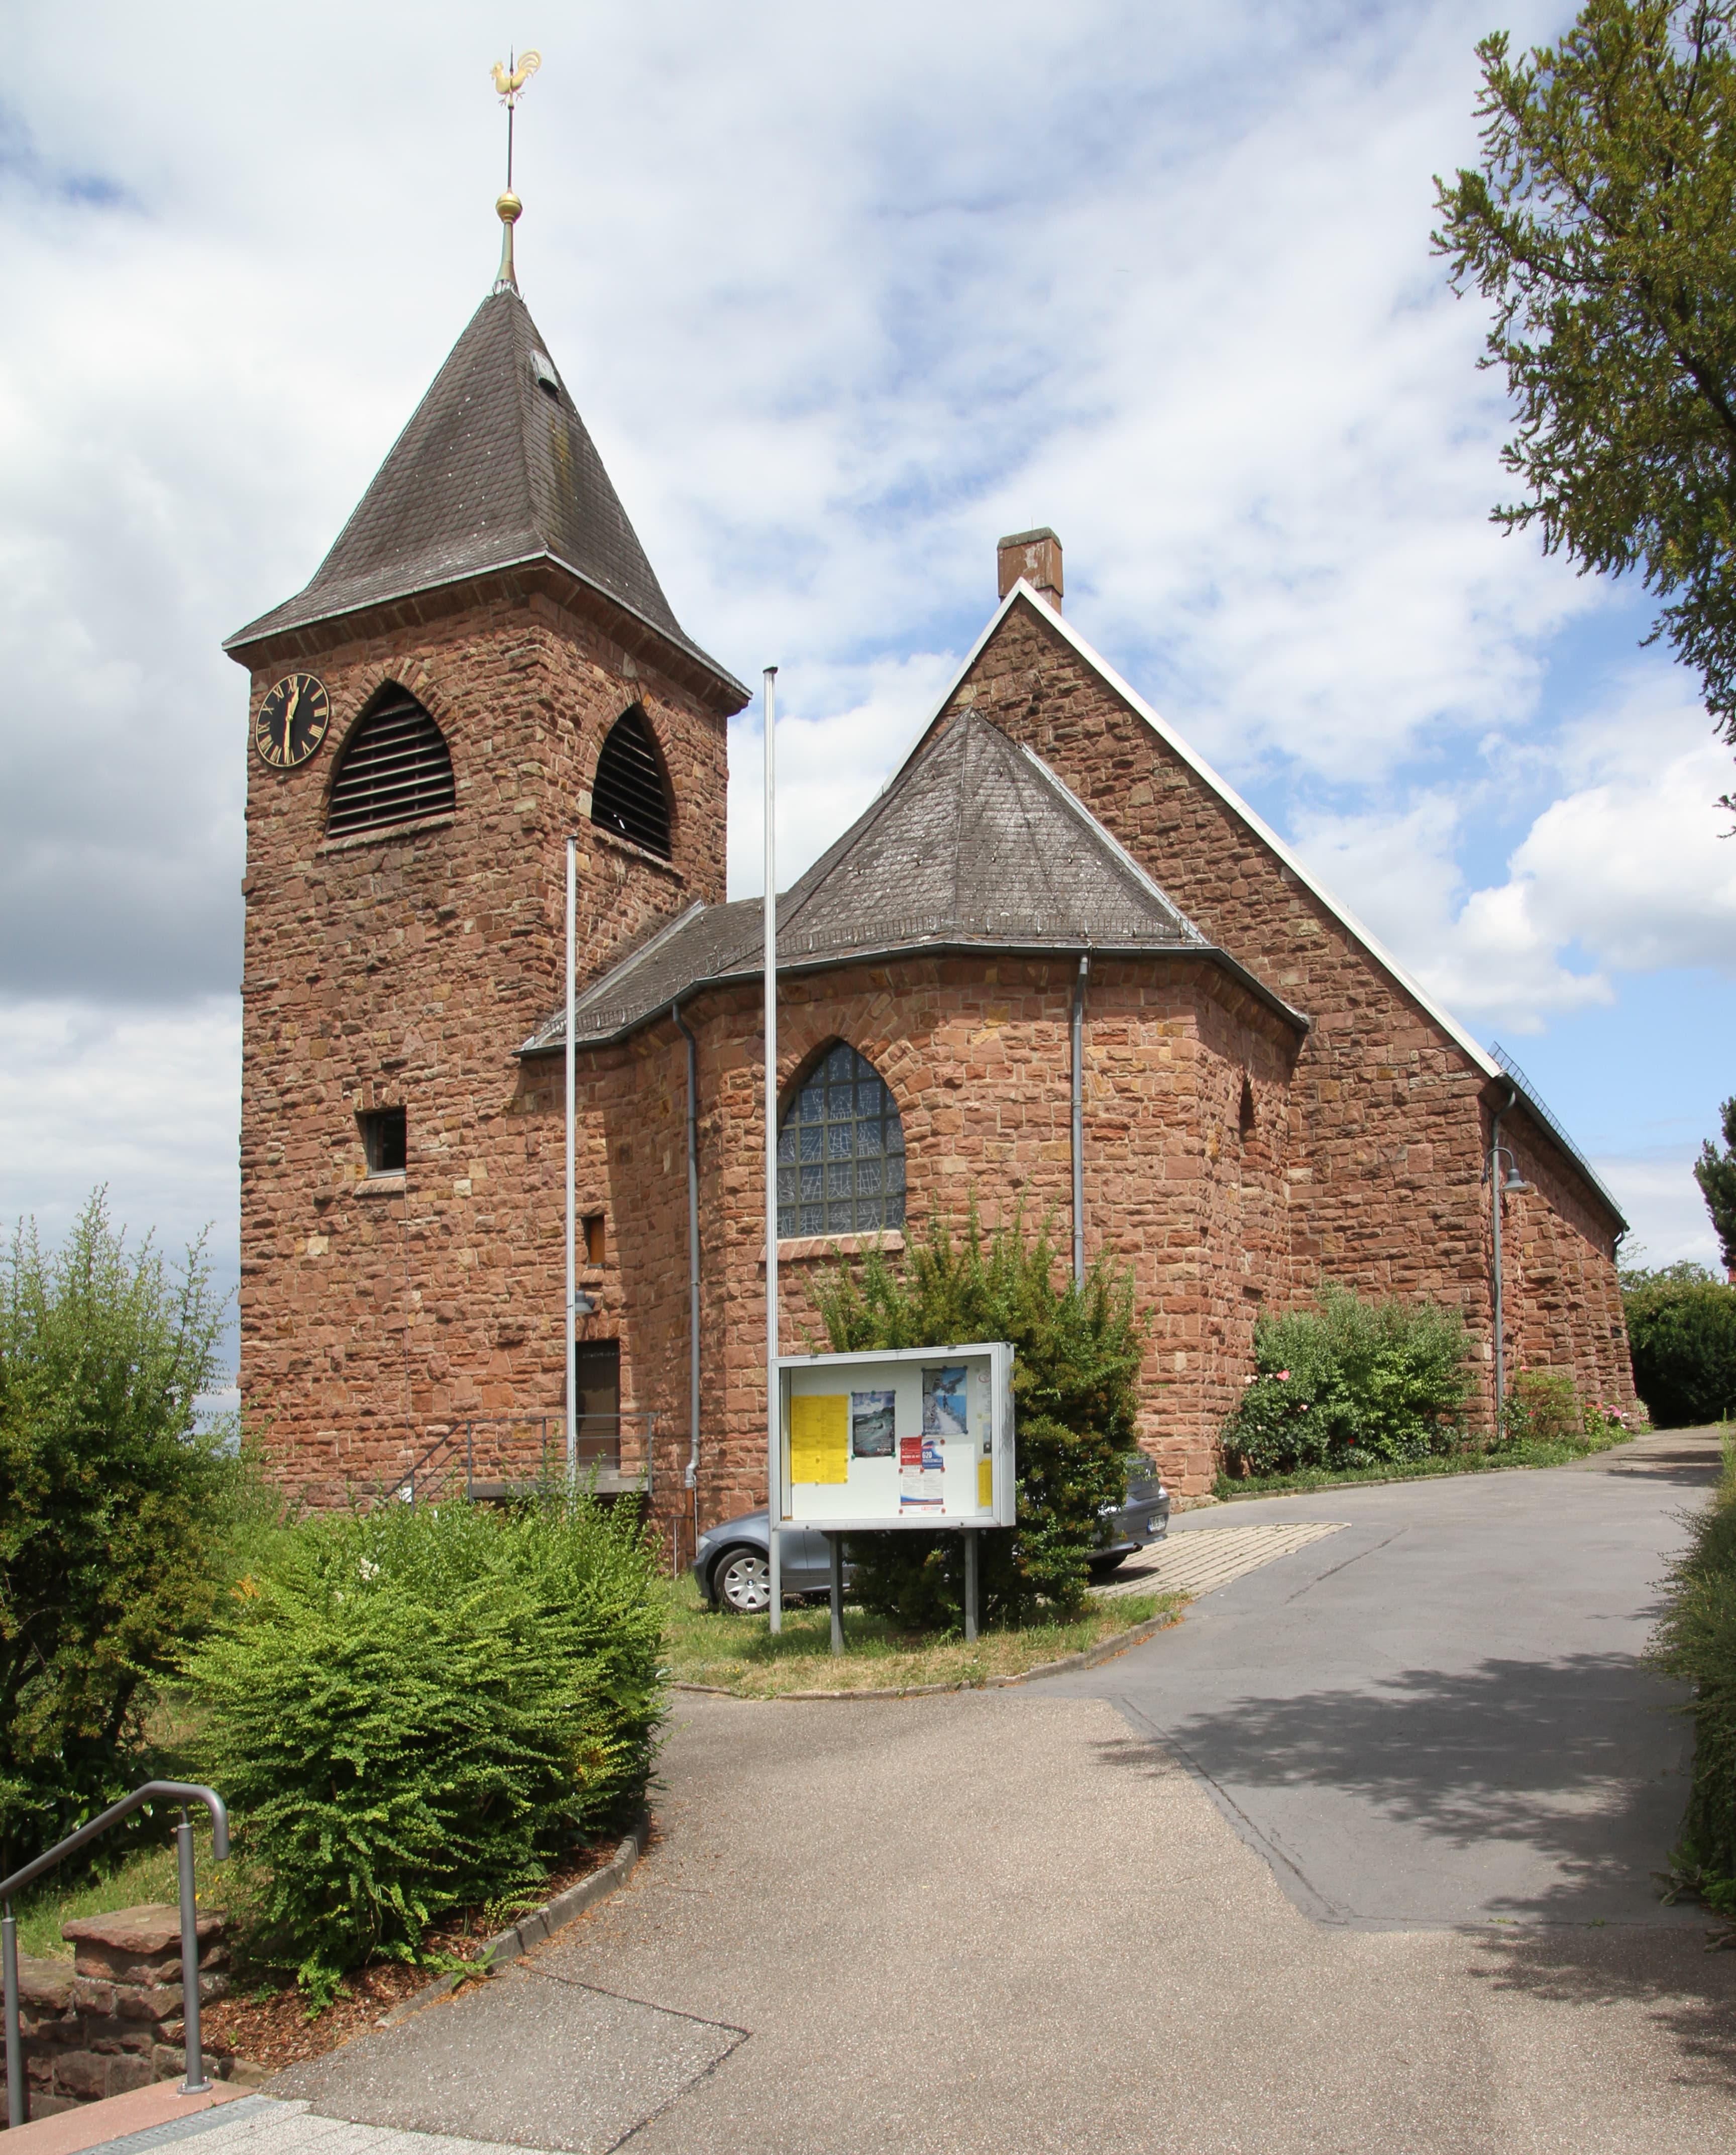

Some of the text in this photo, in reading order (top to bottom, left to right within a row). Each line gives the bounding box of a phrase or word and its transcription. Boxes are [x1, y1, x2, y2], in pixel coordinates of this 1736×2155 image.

[287, 675, 298, 694] XII
[302, 677, 310, 693] I
[273, 685, 284, 702] XI
[310, 688, 323, 702] II
[262, 703, 274, 715] X
[258, 721, 271, 734] IX
[301, 740, 310, 755] V
